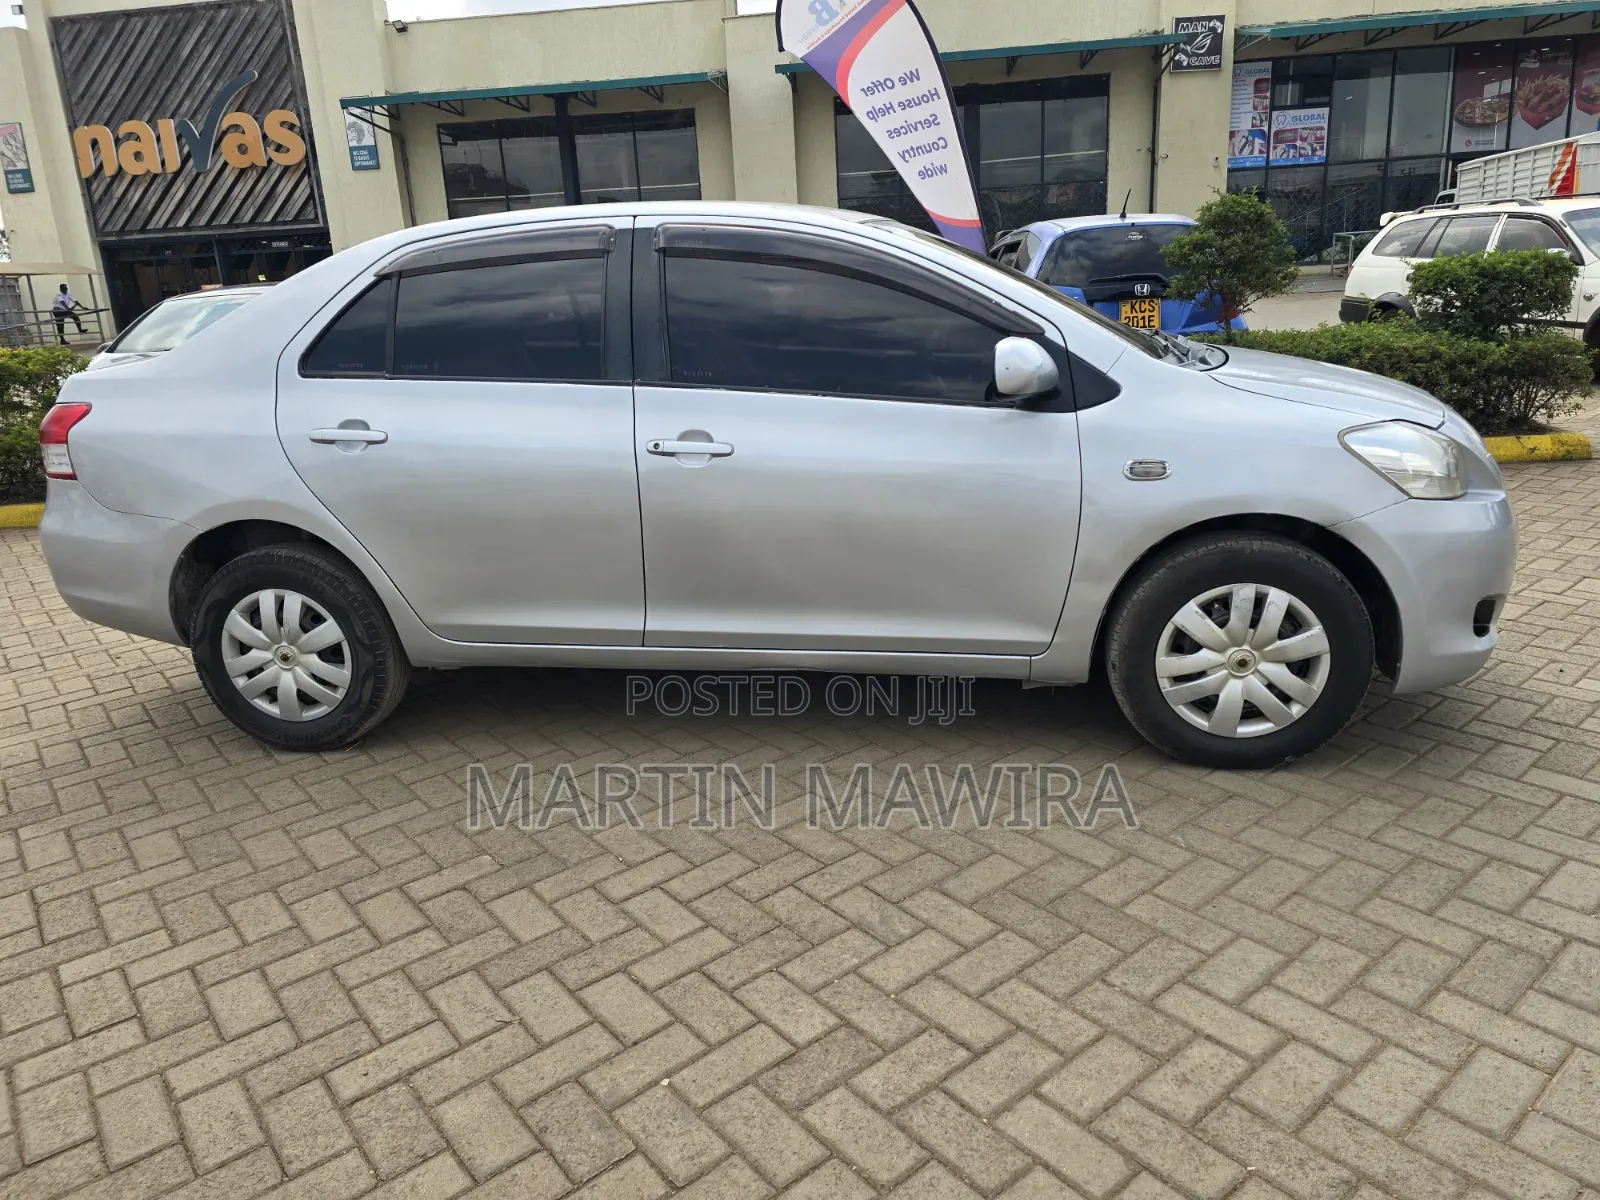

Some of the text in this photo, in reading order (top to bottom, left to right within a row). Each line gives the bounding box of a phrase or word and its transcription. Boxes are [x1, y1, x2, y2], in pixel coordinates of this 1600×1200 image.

[1178, 21, 1209, 33] MAN
[1189, 55, 1220, 66] CAVE
[1245, 67, 1270, 75] GLOBAL
[1291, 113, 1327, 122] GLOBAL
[73, 69, 307, 179] naivas
[1130, 299, 1156, 314] KCS
[1123, 315, 1156, 328] 201E
